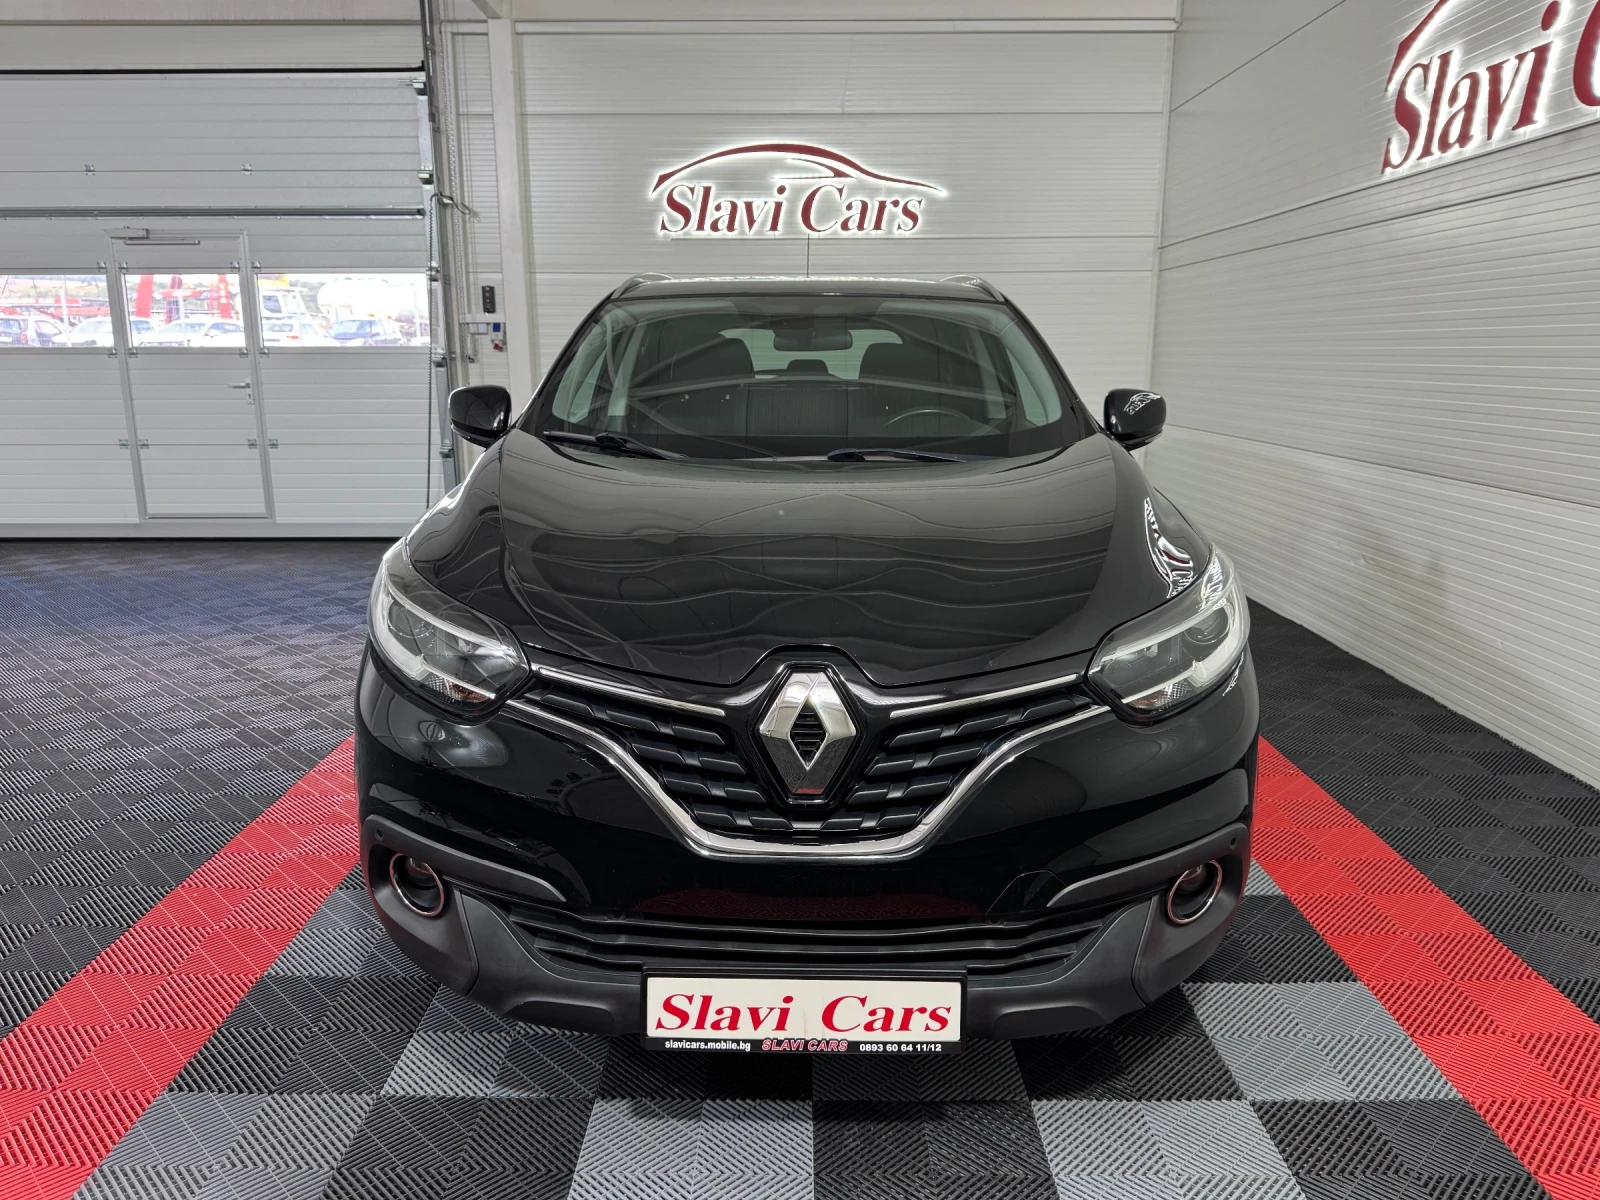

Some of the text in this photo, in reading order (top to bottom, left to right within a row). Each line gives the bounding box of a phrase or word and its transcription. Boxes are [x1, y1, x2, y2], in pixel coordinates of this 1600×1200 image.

[1380, 0, 1559, 174] Slavi
[659, 184, 923, 233] Slavi Cars
[655, 993, 952, 1032] Slavi Cars
[664, 1038, 942, 1052] slavicars.mobile.bg SLAVI CARS 0893 60 64 11/12
